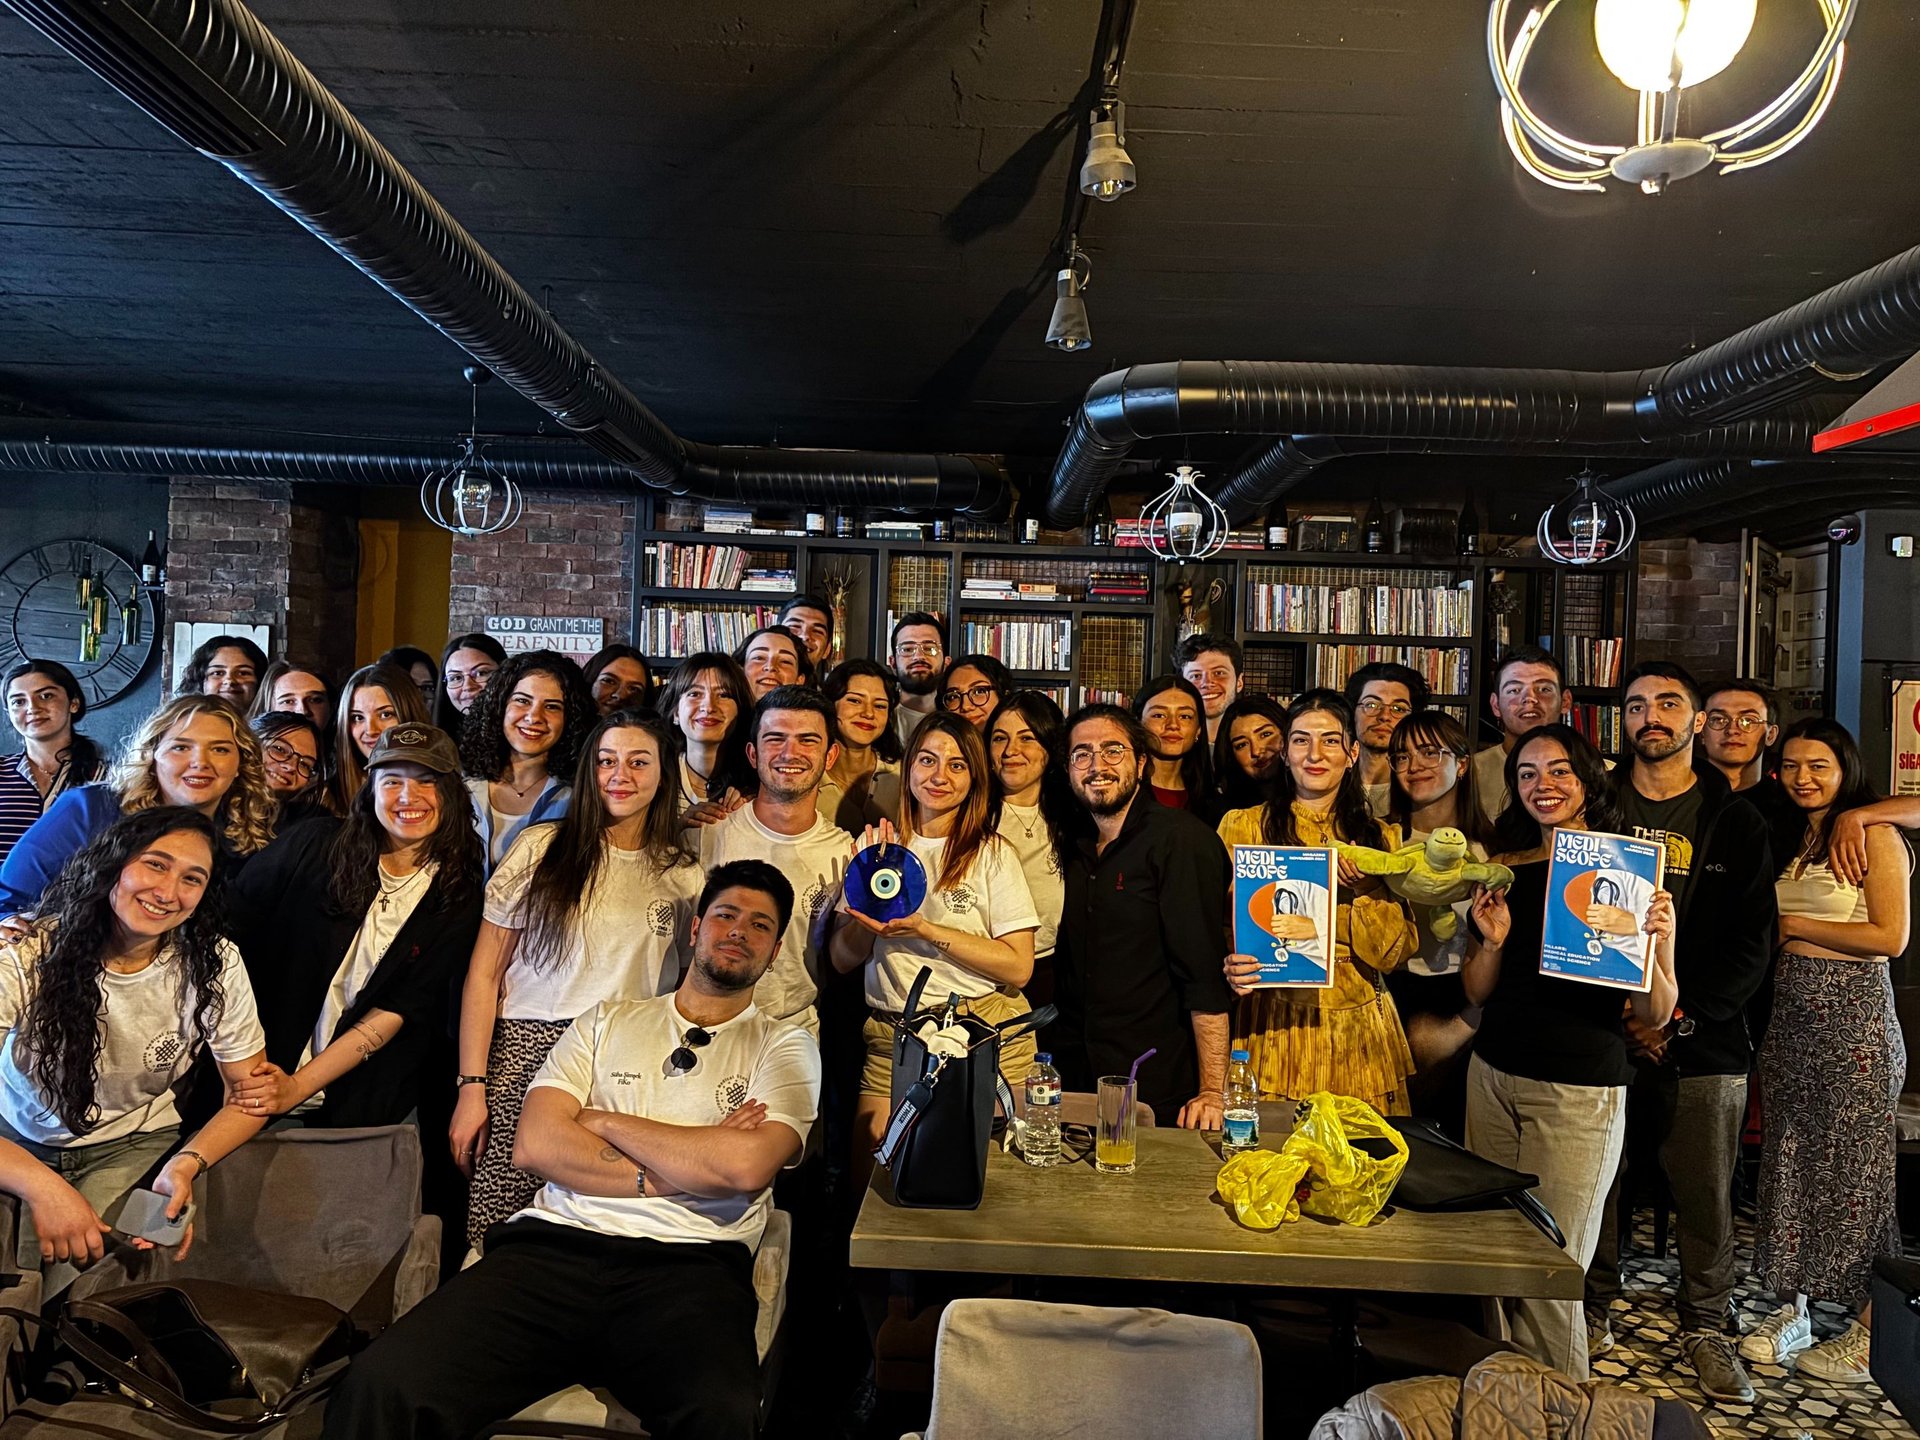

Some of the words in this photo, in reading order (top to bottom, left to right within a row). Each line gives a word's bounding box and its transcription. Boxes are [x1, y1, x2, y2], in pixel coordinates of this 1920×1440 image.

[487, 617, 527, 630] GOD
[529, 617, 562, 632] GRANT
[565, 619, 579, 632] ME
[581, 619, 601, 633] THE
[499, 635, 600, 651] ERENITY
[1632, 826, 1666, 842] THE
[1557, 833, 1610, 852] MEDI-
[1236, 850, 1285, 865] MEDI-
[1555, 848, 1613, 868] SCOPE
[1236, 864, 1288, 880] SCOPE
[1664, 867, 1690, 877] LORIN
[1543, 949, 1567, 957] MEDICAL
[1567, 952, 1601, 962] EDUCATION
[1543, 954, 1566, 962] MEDICAL
[1566, 958, 1592, 966] SCIENCE
